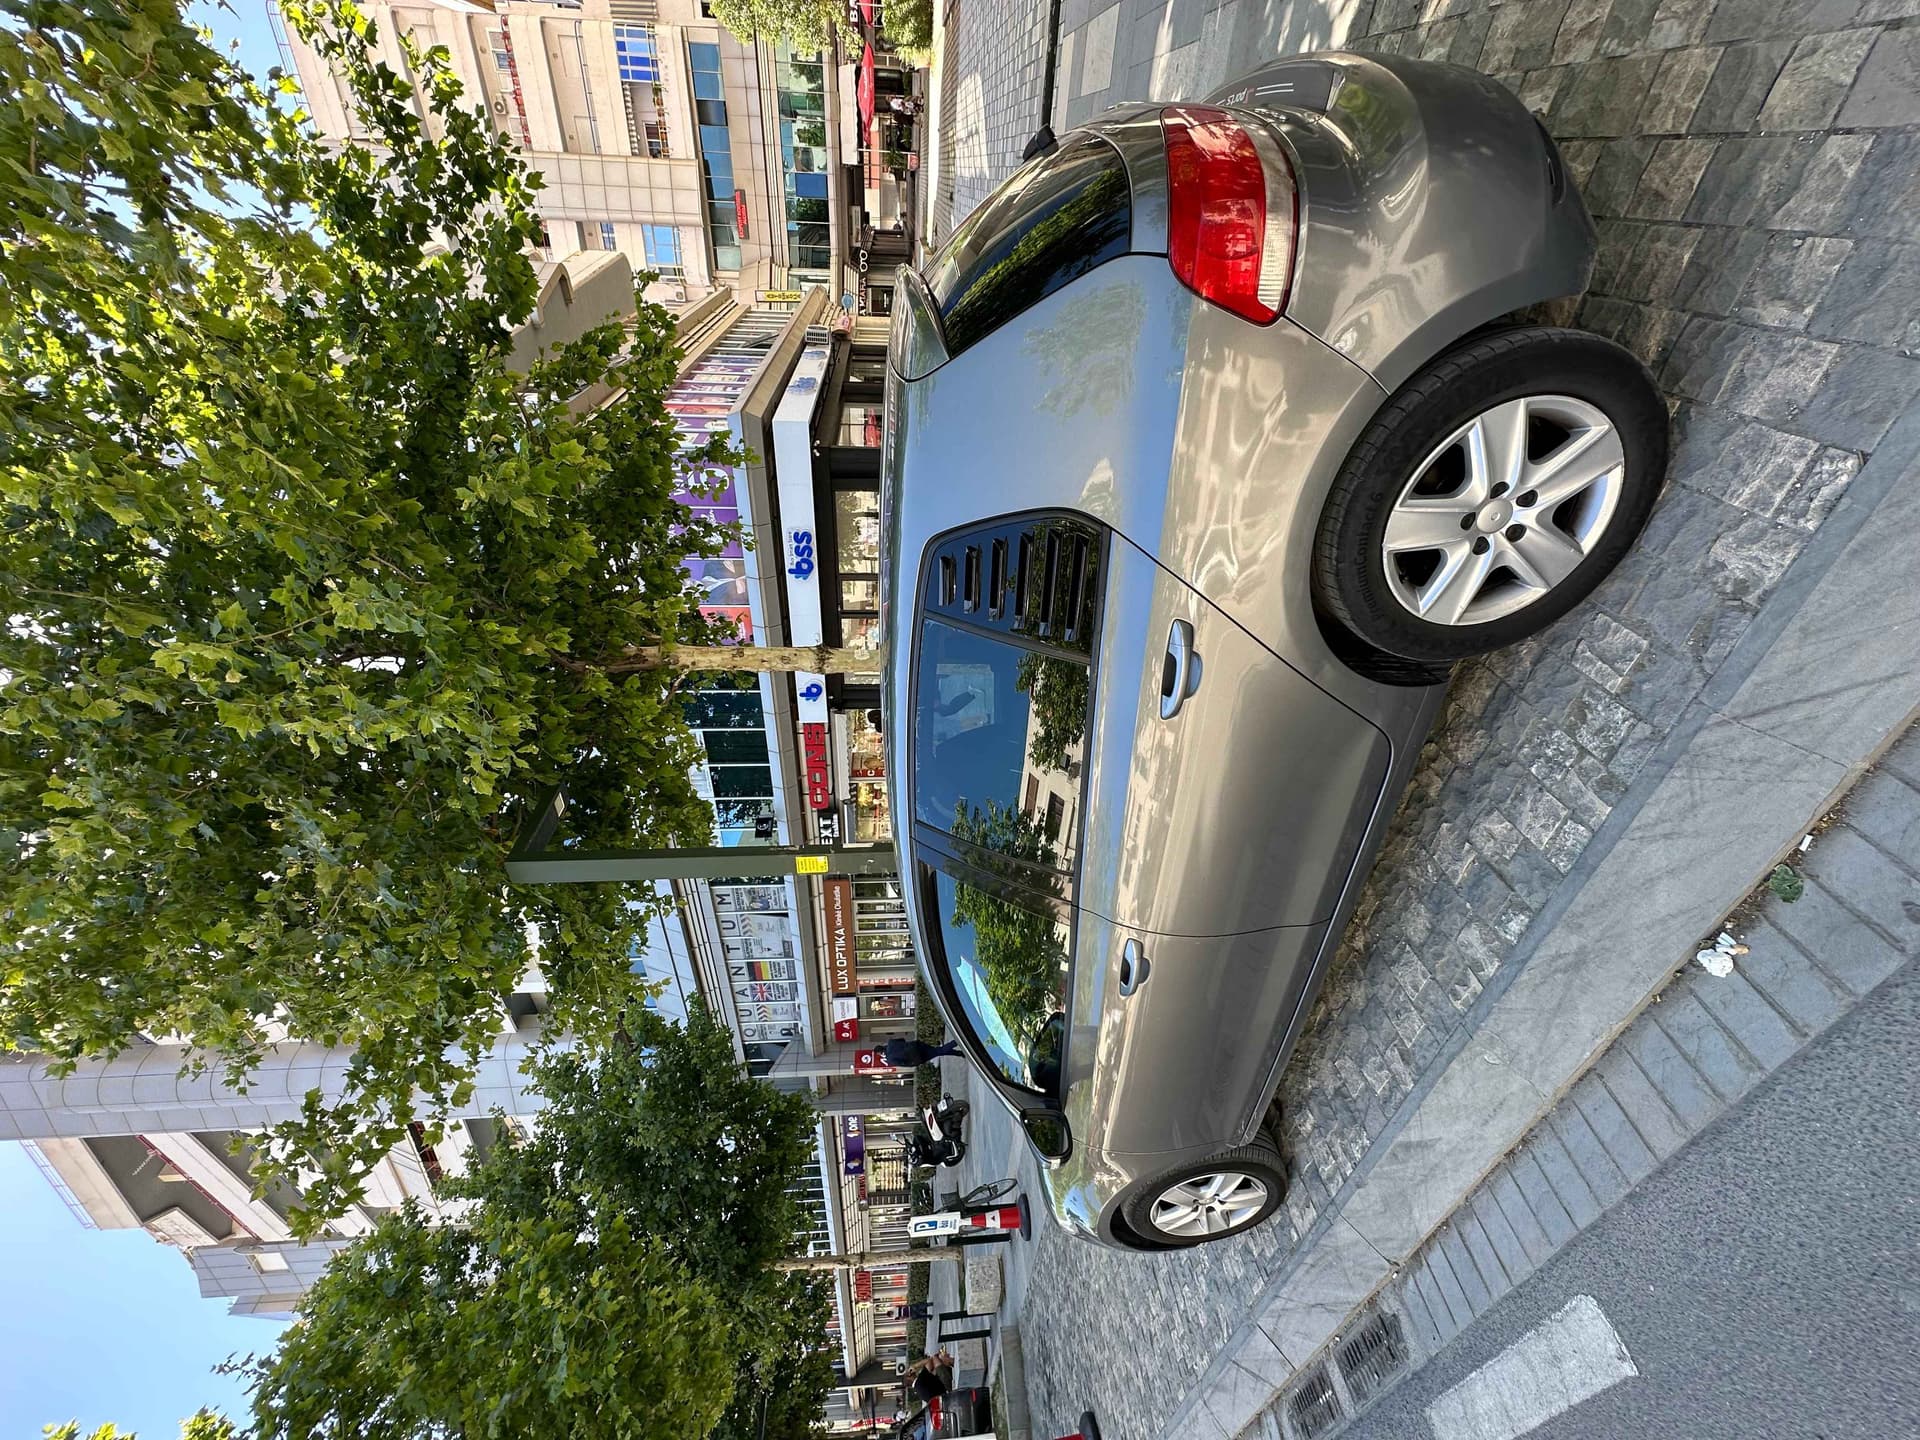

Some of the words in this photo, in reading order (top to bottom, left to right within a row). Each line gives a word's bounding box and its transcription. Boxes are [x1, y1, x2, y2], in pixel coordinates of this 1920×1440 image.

[788, 531, 814, 578] bss
[803, 723, 829, 809] CONS
[819, 817, 833, 845] EXT
[715, 893, 756, 1037] QUANTUM
[834, 928, 847, 967] OPTIKA
[836, 969, 849, 990] LUX
[856, 1272, 871, 1302] CONAD
